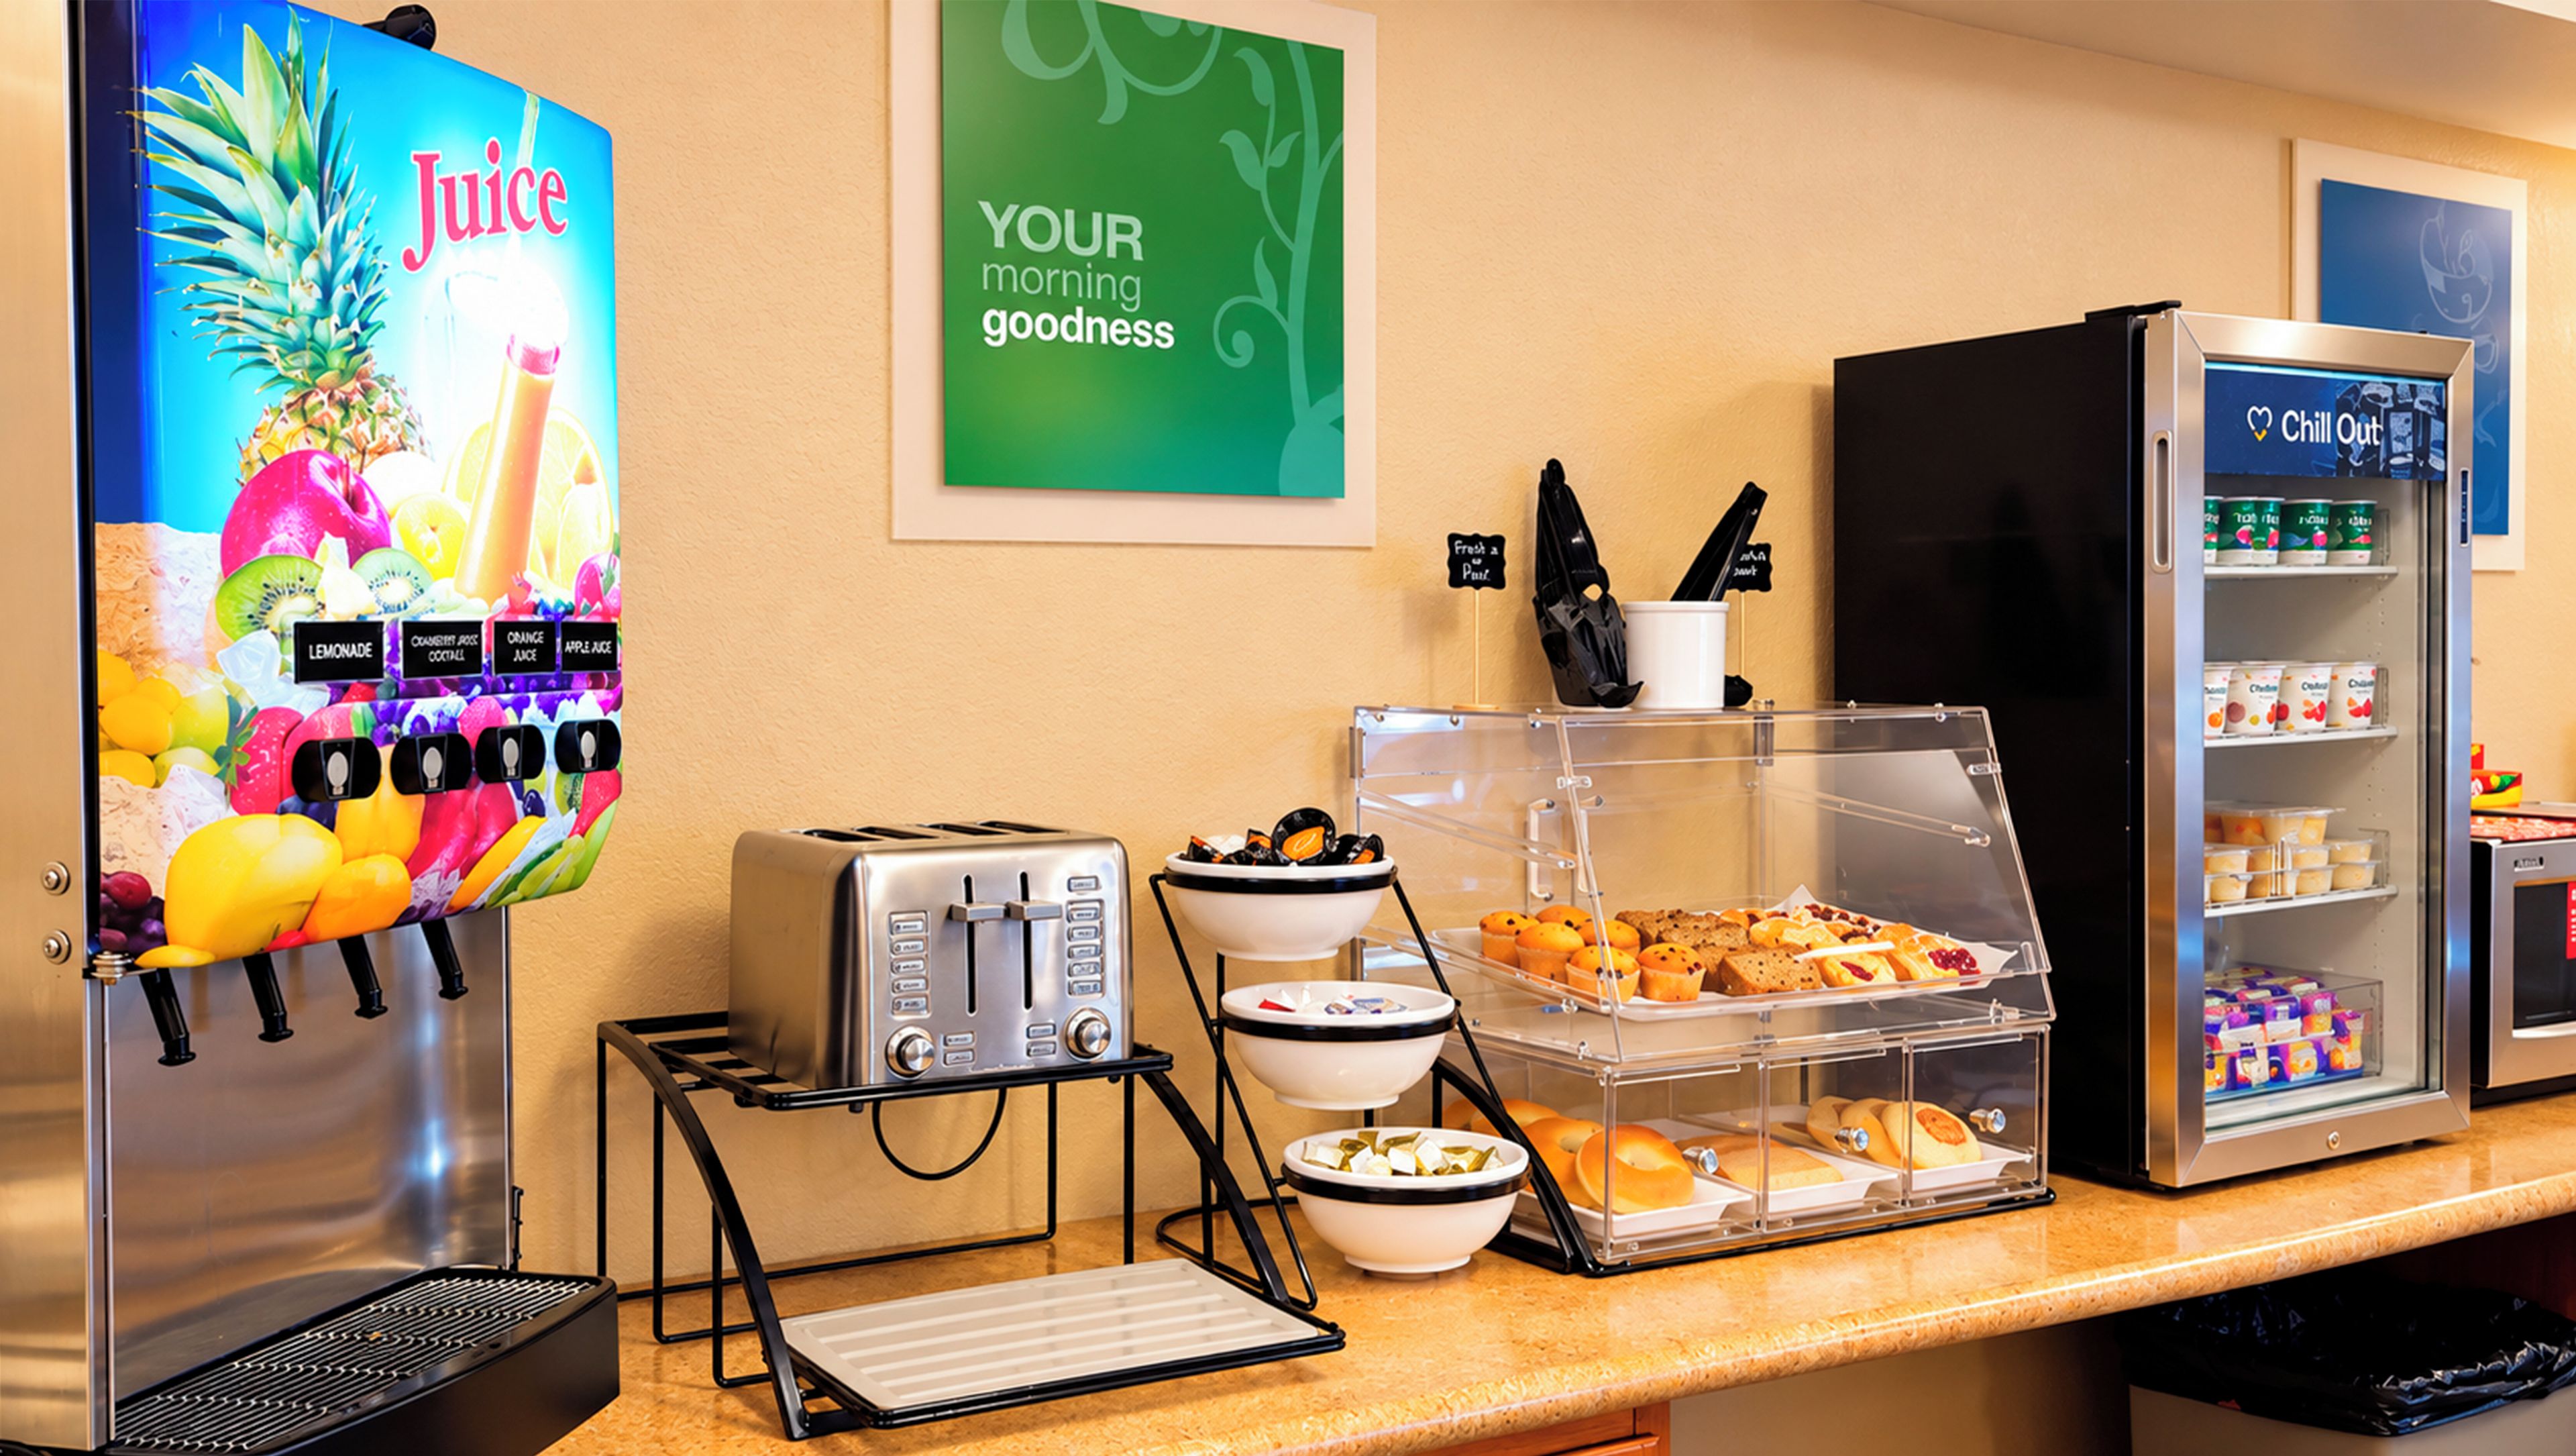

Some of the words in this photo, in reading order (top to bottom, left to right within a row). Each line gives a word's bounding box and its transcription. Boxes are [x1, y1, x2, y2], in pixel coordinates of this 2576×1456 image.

[402, 138, 568, 272] Juice
[977, 200, 1144, 261] YOUR
[982, 262, 1141, 313] morning
[981, 306, 1175, 349] goodness
[2281, 409, 2332, 444] Chill
[2336, 413, 2383, 446] Out
[309, 641, 374, 660] LEMONADE
